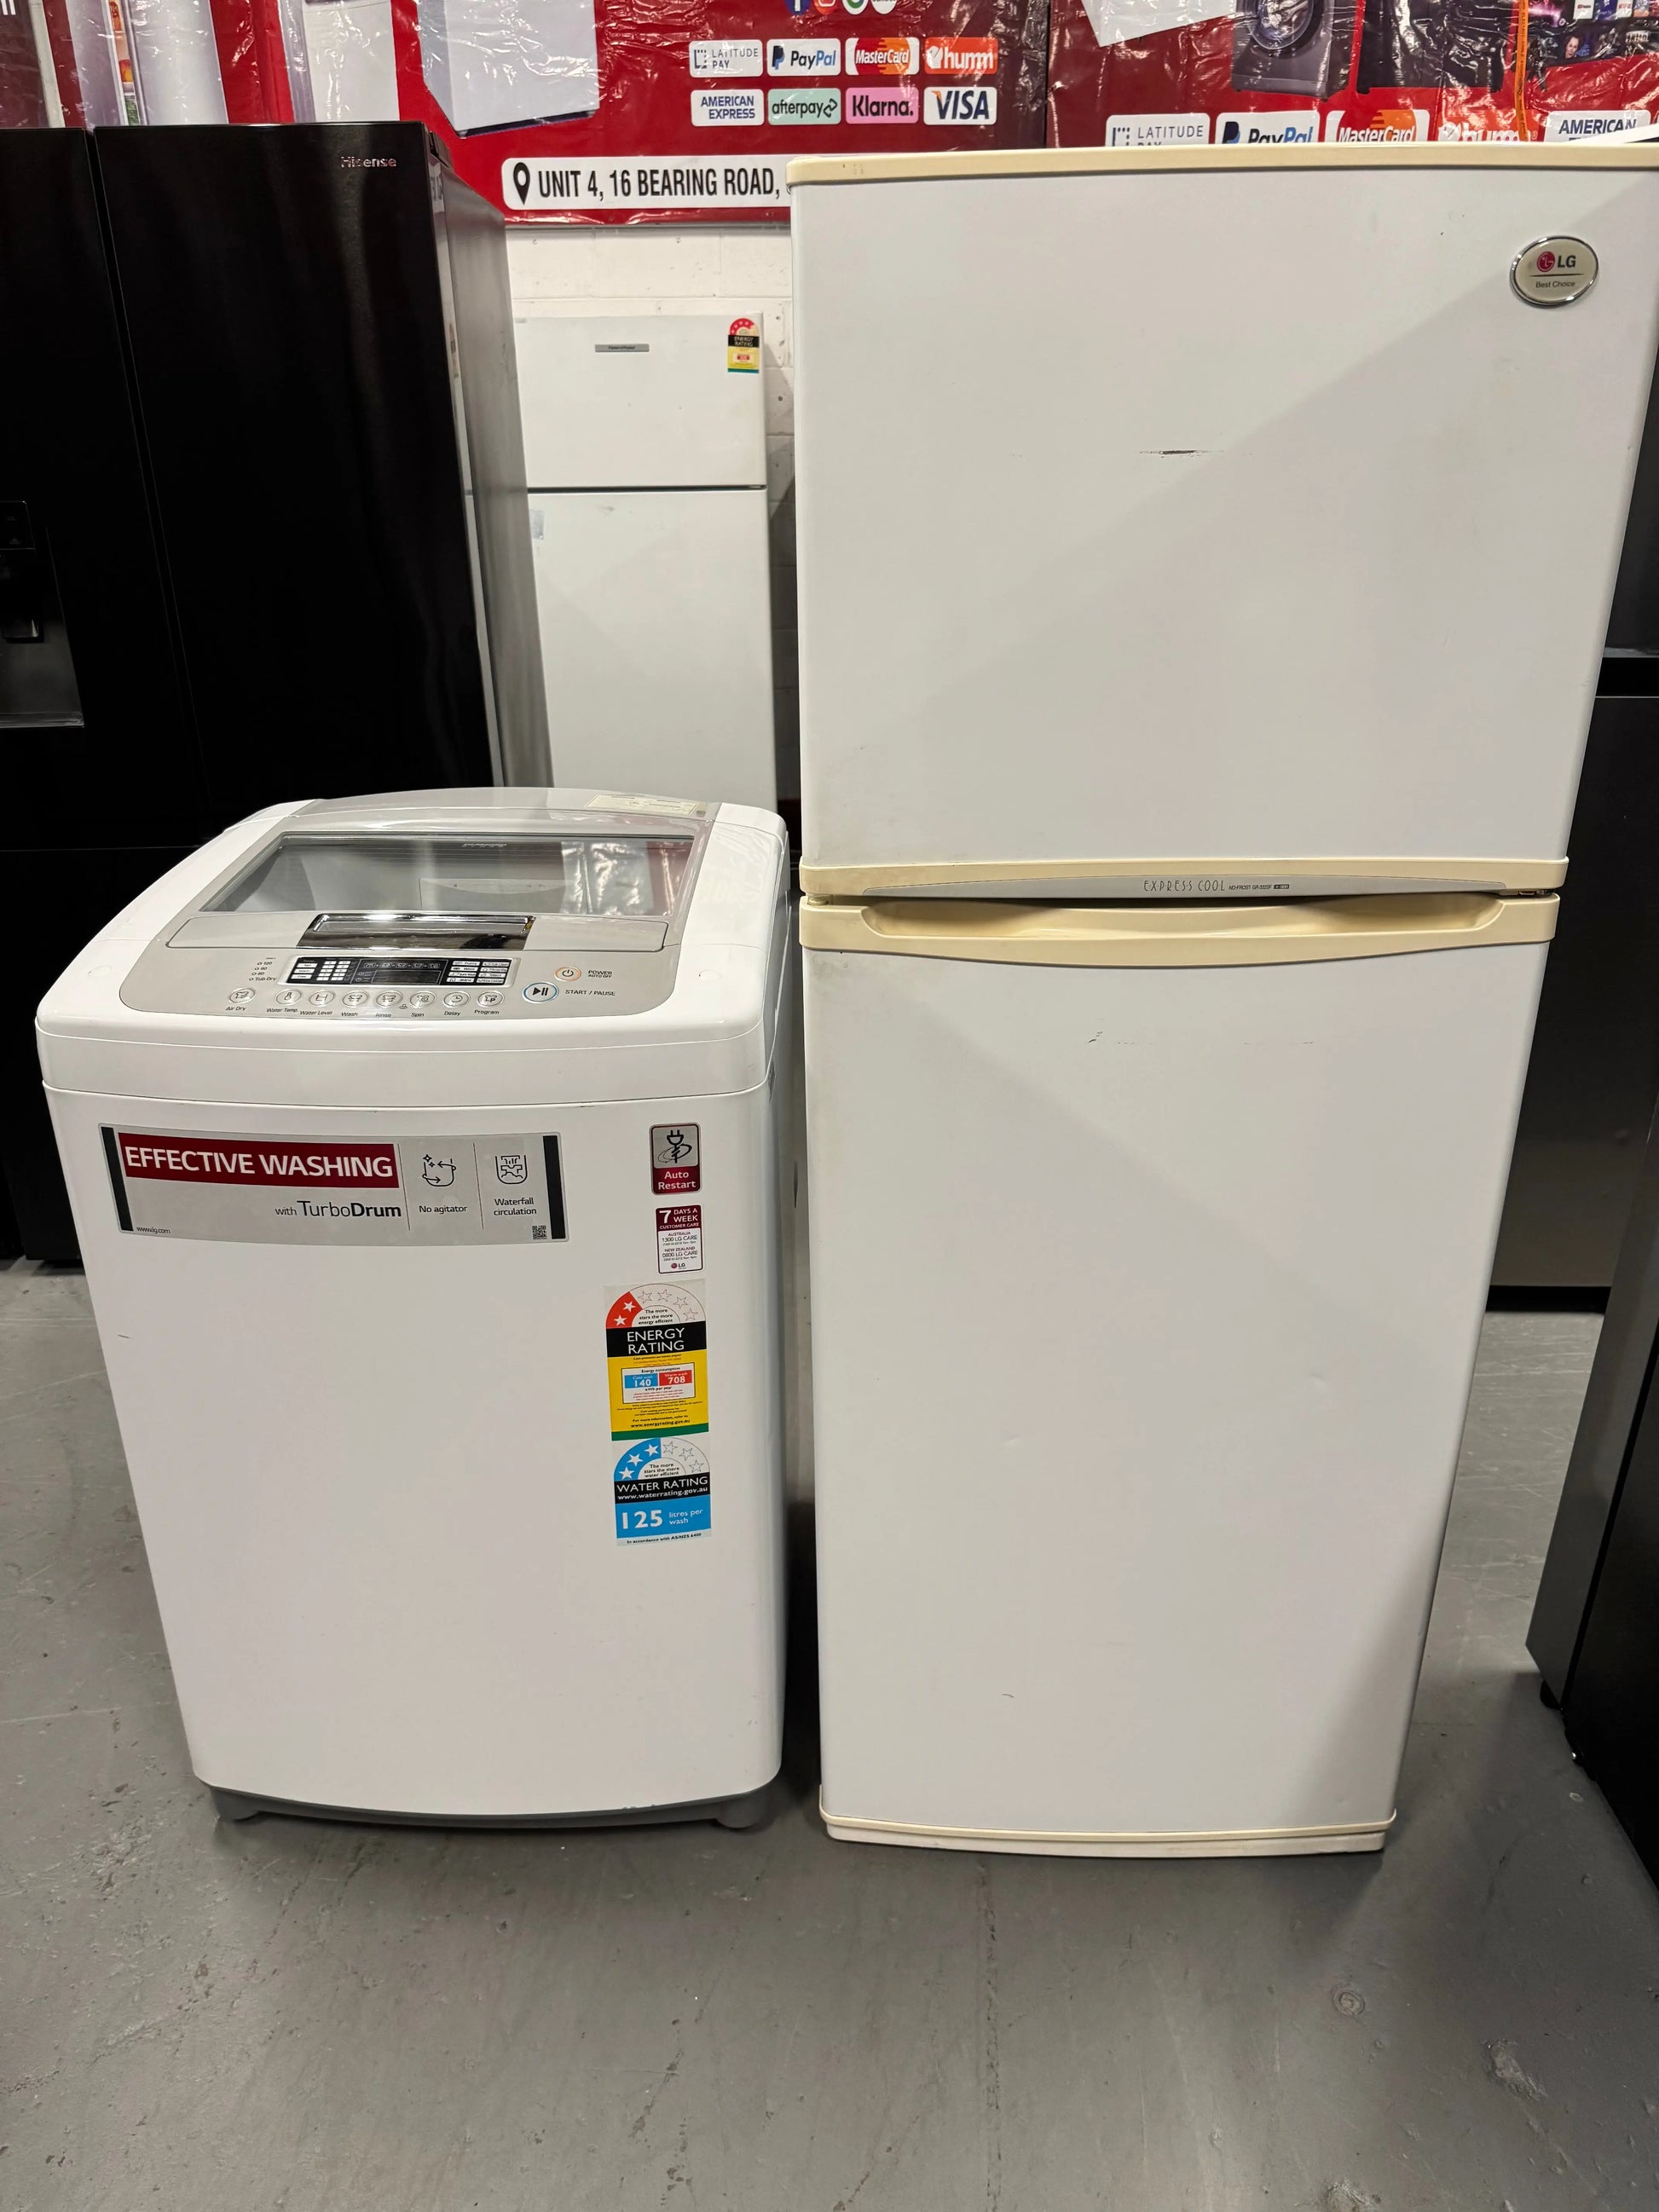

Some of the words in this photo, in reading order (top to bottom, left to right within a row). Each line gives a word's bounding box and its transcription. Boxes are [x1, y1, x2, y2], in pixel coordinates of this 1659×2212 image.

[712, 49, 759, 58] LATITUDE
[791, 50, 836, 69] PayPal
[856, 49, 910, 64] MasterCard
[701, 95, 754, 107] AMERICAN
[853, 95, 914, 117] Klarna.
[932, 90, 990, 119] VISA
[708, 109, 755, 119] EXPRESS
[772, 100, 824, 118] afterpay
[1137, 126, 1204, 139] LATITUDE
[1558, 118, 1637, 135] AMERICAN
[1248, 126, 1314, 143] PayPal
[1339, 126, 1416, 142] MasterCard
[341, 156, 397, 168] Hisense
[538, 170, 581, 198] UNIT
[587, 170, 604, 201] 4,
[610, 170, 632, 197] 16
[639, 169, 717, 196] BEARING
[724, 168, 781, 199] ROAD,
[1557, 255, 1577, 269] LG
[1553, 280, 1575, 288] Choice
[1143, 880, 1193, 892] EXPRESS
[1198, 880, 1225, 892] COOL
[124, 1146, 256, 1175] EFFECTIVE
[258, 1154, 393, 1177] WASHING
[664, 1171, 689, 1180] Auto
[658, 1181, 697, 1190] Restart
[275, 1207, 297, 1216] with
[297, 1200, 402, 1217] TurboDrum
[494, 1198, 534, 1206] Waterfall
[434, 1205, 468, 1215] agitator
[494, 1208, 537, 1216] circulation
[659, 1210, 672, 1224] 7
[673, 1215, 699, 1223] WEEK
[627, 1327, 685, 1342] ENERGY
[627, 1340, 685, 1354] RATING
[668, 1376, 686, 1384] 708
[616, 1482, 660, 1493] WATER
[663, 1476, 708, 1489] RATING
[617, 1487, 708, 1500] www.waterrating.gov.au
[621, 1510, 663, 1530] 125
